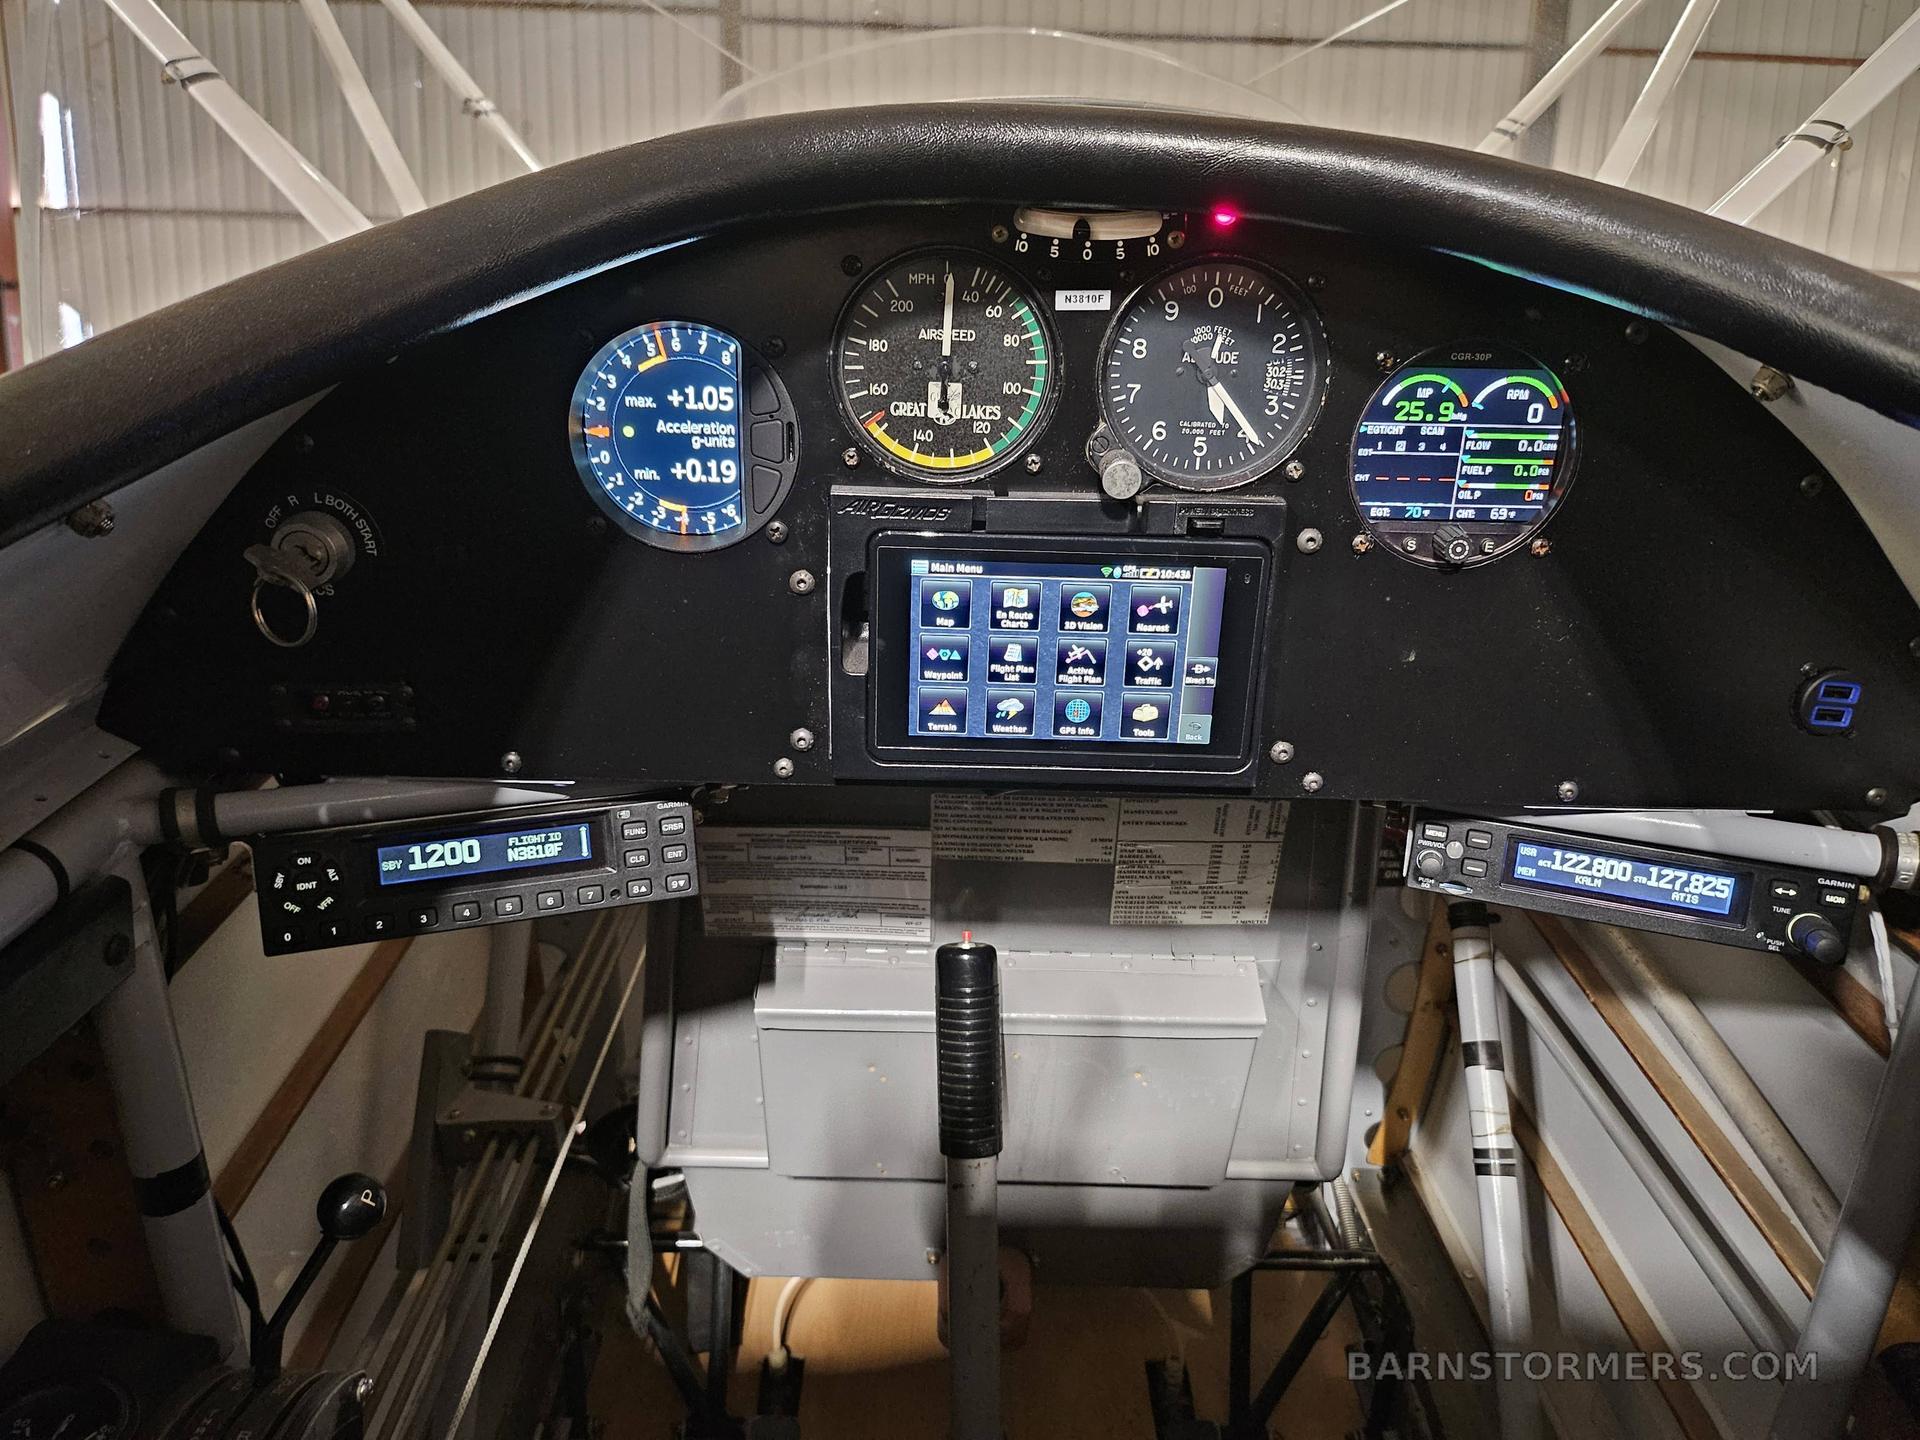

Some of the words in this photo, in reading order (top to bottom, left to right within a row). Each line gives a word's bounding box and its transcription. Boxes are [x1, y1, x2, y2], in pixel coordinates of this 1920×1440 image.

[1015, 240, 1028, 252] 10
[1050, 246, 1059, 257] 5
[1083, 249, 1092, 260] 0
[1116, 248, 1125, 260] 5
[1147, 244, 1159, 256] 10
[909, 274, 934, 284] MPH
[963, 291, 979, 302] 40
[1184, 285, 1196, 294] 100
[1230, 285, 1249, 297] FEET
[1065, 295, 1104, 303] N3810F
[1208, 287, 1223, 308] 0
[890, 300, 913, 312] 200
[986, 306, 1002, 317] 60
[1165, 301, 1179, 321] 9
[1257, 304, 1262, 323] 1
[919, 329, 975, 341] AIRSEED
[1194, 326, 1211, 335] 1000
[1214, 326, 1232, 336] FEET
[672, 339, 681, 352] 6
[869, 340, 887, 351] 180
[1004, 335, 1019, 346] 80
[1272, 334, 1287, 354] 2
[647, 343, 656, 356] 5
[698, 339, 707, 354] 7
[1132, 338, 1147, 358] 8
[622, 355, 631, 368] 4
[721, 351, 731, 365] 8
[1451, 353, 1492, 361] CGR-30P
[607, 375, 616, 388] 3
[870, 384, 888, 395] 160
[1003, 383, 1021, 394] 100
[1127, 384, 1141, 403] 7
[1417, 388, 1433, 398] MP
[625, 395, 656, 409] max.
[667, 386, 734, 411] +1.05
[1507, 389, 1529, 400] RPM
[597, 397, 605, 411] 2
[1264, 395, 1278, 415] 3
[890, 402, 926, 416] GREAT
[962, 406, 1001, 419] LAKES
[1394, 401, 1454, 421] 25.9
[1527, 403, 1544, 423] 0
[656, 420, 735, 435] Acceleration
[973, 422, 991, 433] 120
[1152, 421, 1167, 440] 6
[1420, 427, 1445, 435] SCAN
[692, 434, 735, 449] g-units
[914, 430, 933, 442] 140
[1193, 437, 1207, 457] 5
[1377, 442, 1382, 450] 1
[1418, 442, 1425, 451] 3
[1440, 443, 1446, 451] 4
[1465, 441, 1491, 450] FLOW
[1518, 440, 1543, 452] 0.0
[600, 451, 609, 464] 0
[635, 468, 660, 481] min.
[671, 459, 736, 483] +0.19
[1461, 466, 1484, 474] FUEL
[1514, 465, 1538, 476] 0.0
[609, 474, 624, 486] -1
[287, 495, 300, 507] R
[314, 492, 322, 504] L
[629, 493, 643, 505] -2
[1525, 490, 1533, 501] 0
[325, 495, 358, 521] BOTH
[651, 507, 666, 519] -3
[722, 504, 735, 516] -6
[1404, 507, 1421, 518] 70
[265, 505, 283, 528] OFF
[702, 513, 715, 525] -5
[1456, 509, 1475, 518] CHT:
[1490, 508, 1507, 520] 69
[355, 519, 378, 557] START
[1407, 539, 1416, 550] S
[1485, 542, 1494, 552] E
[931, 563, 954, 573] Main
[957, 564, 983, 574] Menu
[996, 611, 1007, 619] En
[1009, 612, 1034, 620] Route
[936, 618, 954, 627] Map
[1001, 620, 1028, 628] Charts
[1064, 621, 1076, 629] 3D
[1078, 622, 1103, 630] Vision
[1136, 624, 1169, 632] Nearest
[991, 664, 1013, 674] Flight
[1016, 665, 1034, 673] Plan
[1067, 667, 1094, 675] Active
[924, 671, 963, 680] Waypoint
[1059, 676, 1083, 684] Flight
[928, 723, 957, 731] Terrain
[993, 725, 1027, 733] Weather
[1060, 727, 1076, 735] GPS
[1133, 729, 1154, 737] Tools
[625, 827, 646, 835] FUNC
[662, 823, 683, 831] CRSR
[508, 834, 546, 846] FLIGHT
[548, 832, 561, 841] ID
[1426, 829, 1446, 838] MENU
[1418, 839, 1445, 849] PWR/VOL
[382, 860, 402, 872] SBY
[409, 839, 481, 870] 1200
[507, 842, 564, 862] N3810F
[667, 850, 683, 858] ENT
[1520, 847, 1537, 857] USR
[297, 857, 311, 865] ON
[630, 855, 645, 863] CLR
[327, 869, 339, 881] ALT
[1517, 866, 1536, 877] MEM
[1551, 851, 1633, 882] 122.800
[1648, 867, 1731, 898] 127.825
[274, 873, 285, 889] SBY
[296, 881, 317, 891] IDNT
[1575, 875, 1601, 887] KALM
[1818, 878, 1855, 889] GARMIN
[317, 897, 334, 910] VFR
[546, 897, 554, 905] 6
[1672, 892, 1699, 904] ATIS
[1826, 895, 1845, 904] MON
[283, 902, 301, 913] OFF
[463, 908, 470, 917] 4
[505, 903, 512, 911] 5
[1773, 906, 1791, 914] TUNE
[421, 914, 427, 923] 3
[376, 921, 383, 929] 2
[332, 927, 336, 935] 1
[284, 933, 291, 941] 0
[1767, 939, 1784, 947] PUSH
[360, 1189, 376, 1207] P
